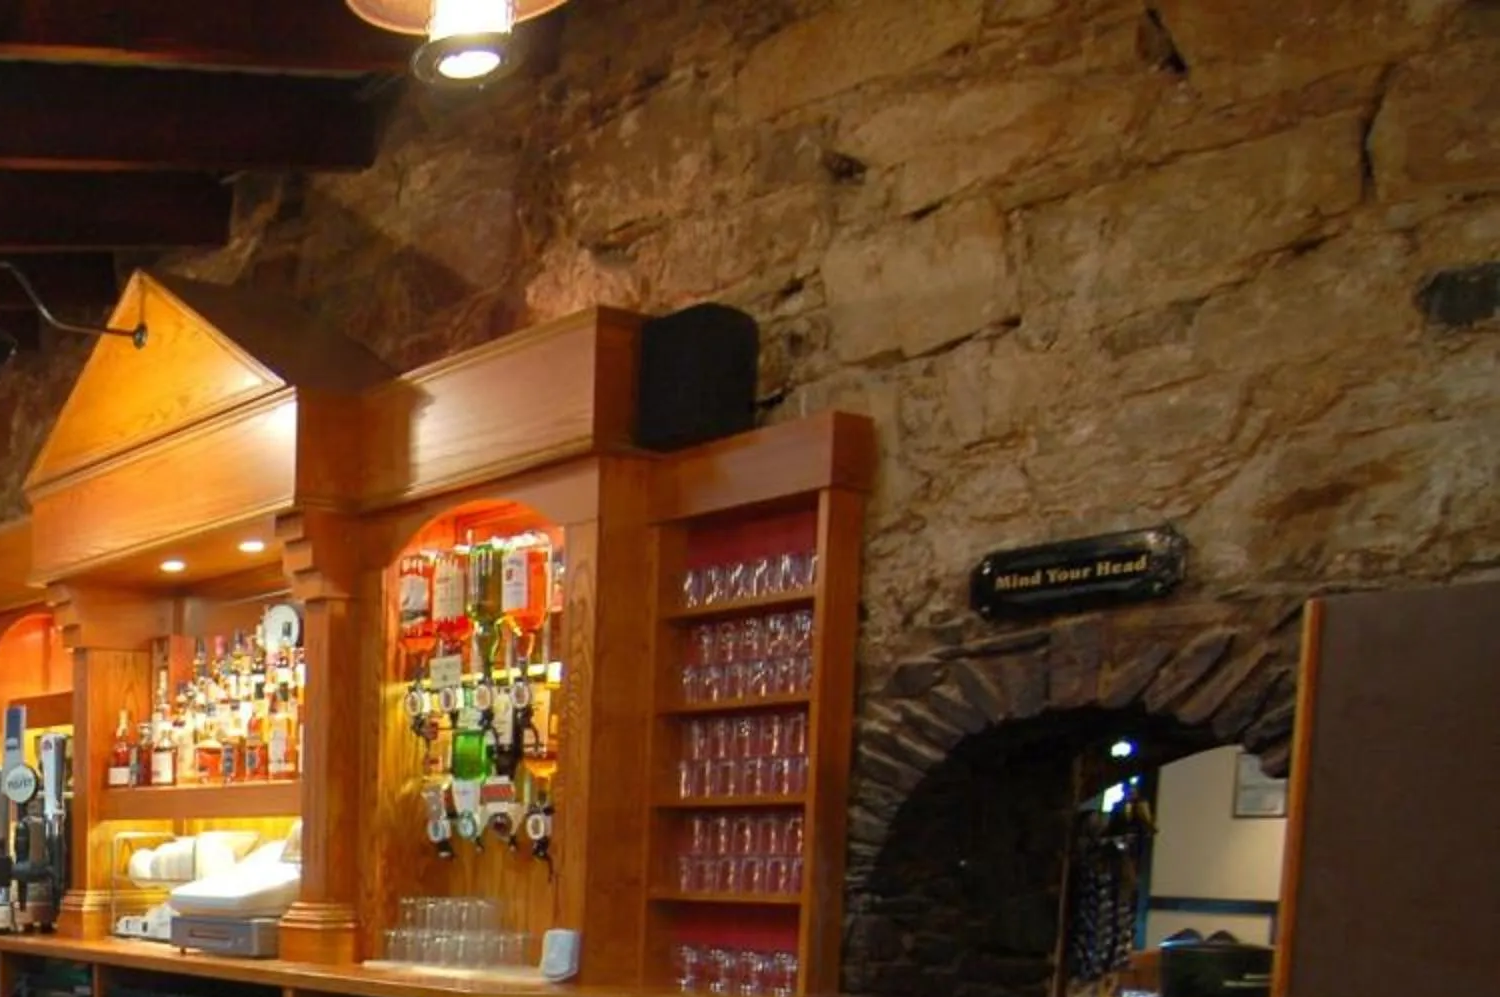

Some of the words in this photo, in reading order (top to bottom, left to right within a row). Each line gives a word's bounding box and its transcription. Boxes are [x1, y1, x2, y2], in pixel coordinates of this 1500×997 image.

[994, 569, 1042, 592] Mind
[1045, 566, 1092, 584] Your
[1096, 554, 1148, 577] Head
